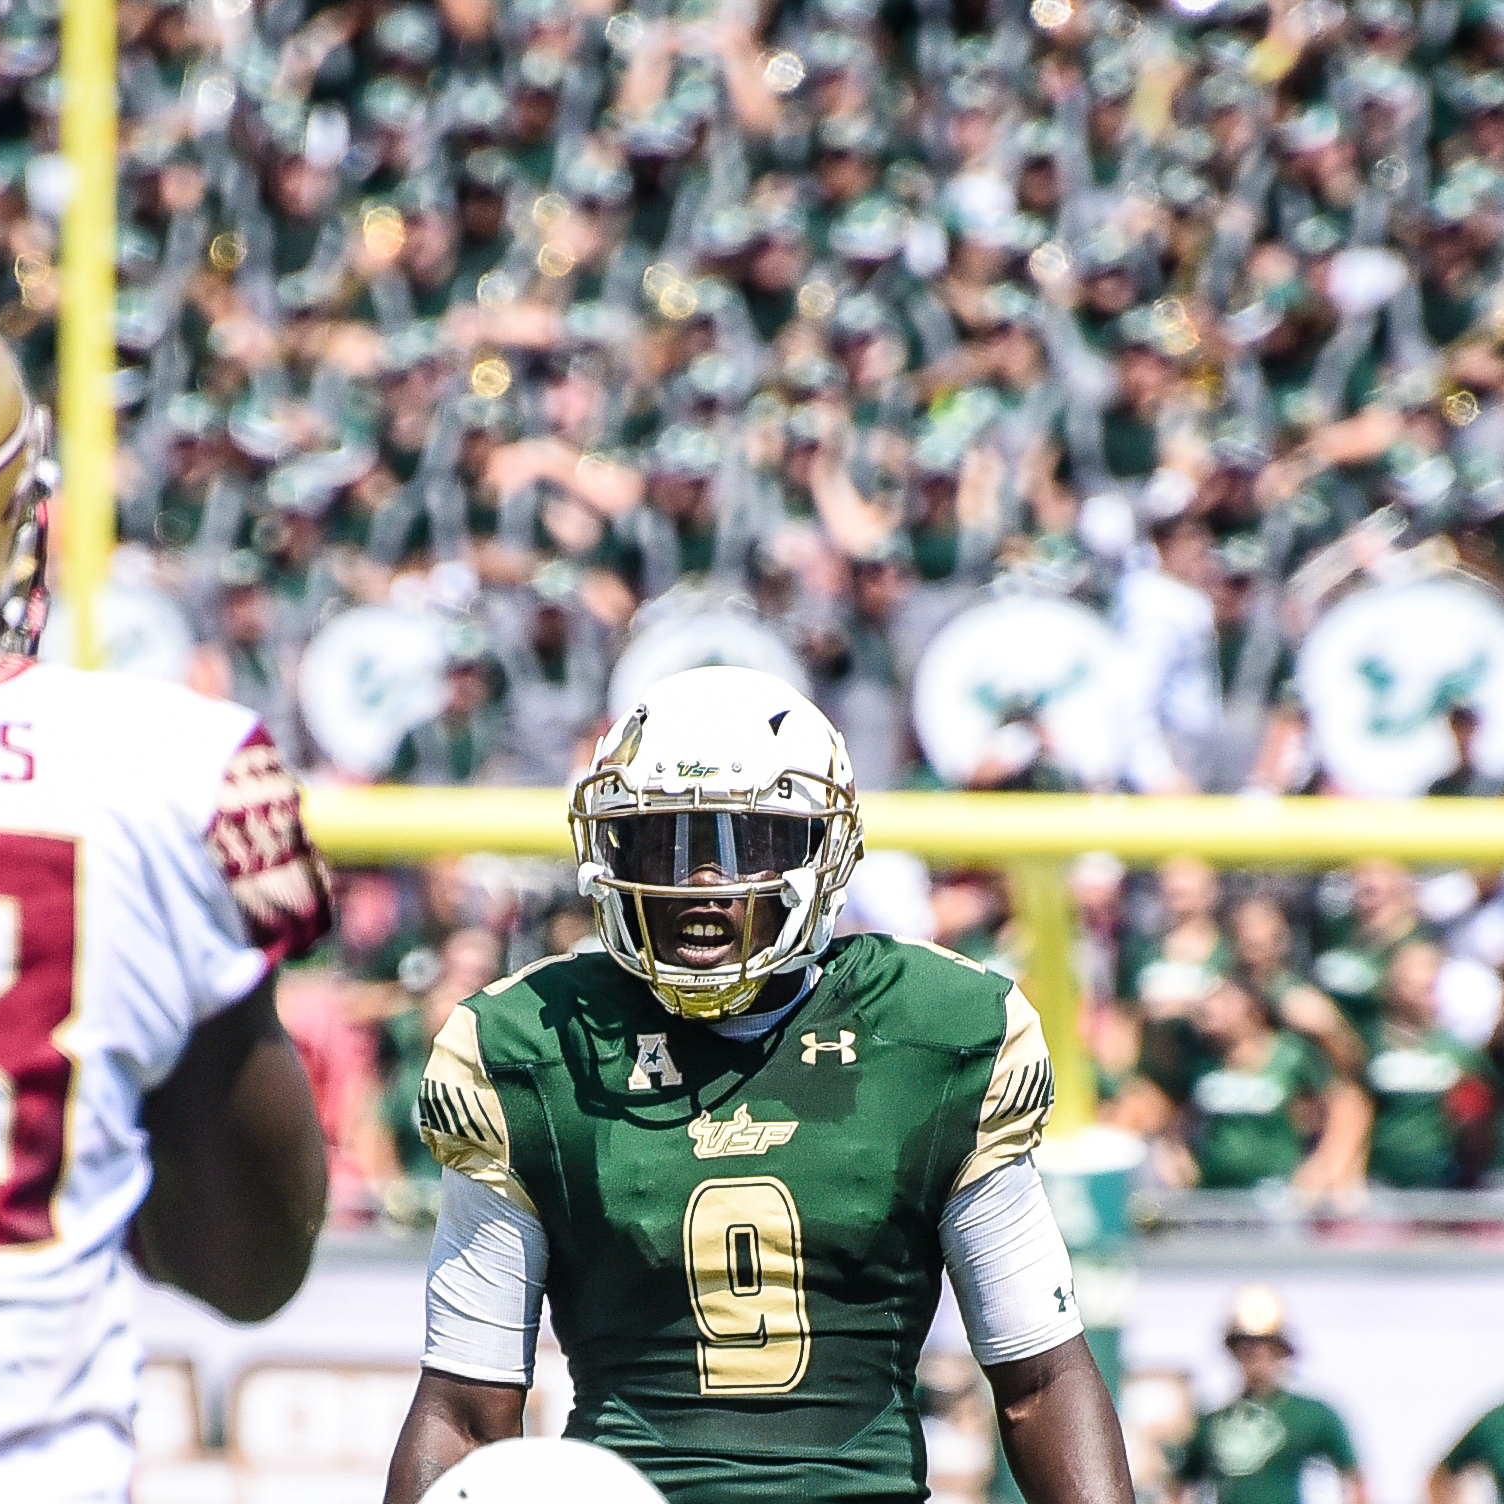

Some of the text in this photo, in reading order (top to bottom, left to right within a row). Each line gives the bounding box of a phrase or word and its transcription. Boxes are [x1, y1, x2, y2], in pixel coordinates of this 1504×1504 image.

[677, 759, 720, 777] USF
[777, 777, 793, 800] 9
[688, 1103, 800, 1159] USF
[683, 1175, 812, 1395] 9
